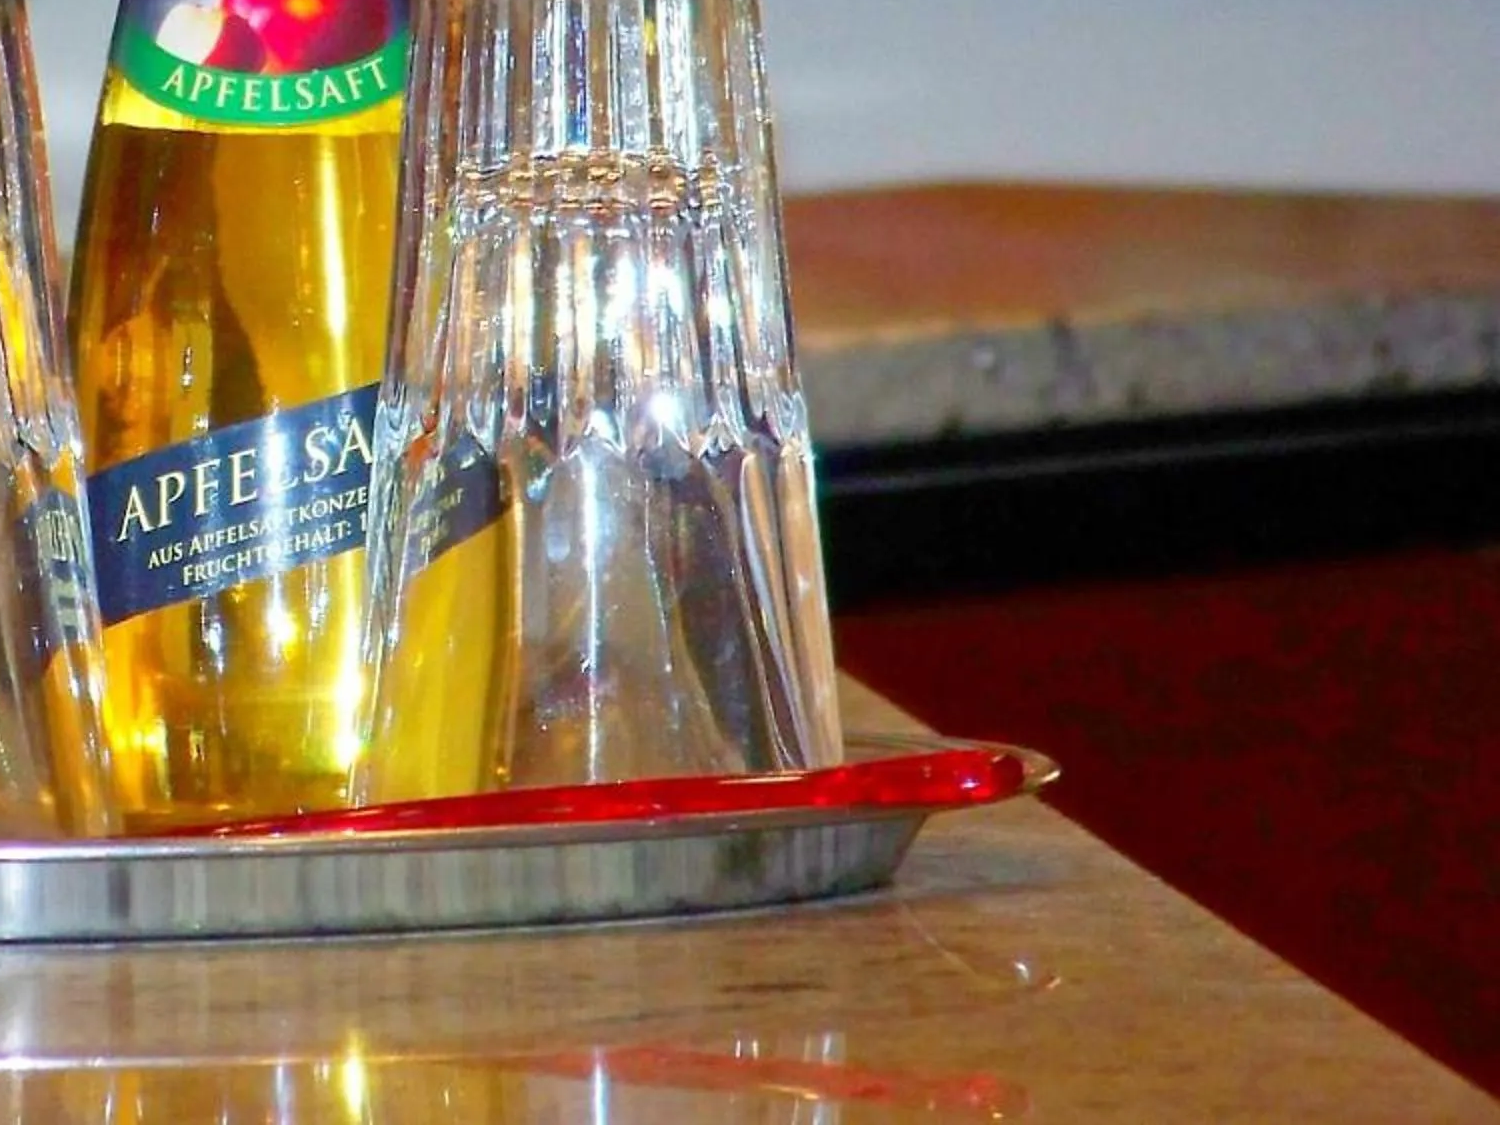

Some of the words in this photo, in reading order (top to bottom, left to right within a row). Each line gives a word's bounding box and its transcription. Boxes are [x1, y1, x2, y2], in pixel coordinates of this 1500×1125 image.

[161, 56, 389, 113] APFELSAFT
[116, 416, 374, 543] APFELSA
[148, 543, 183, 569] AUS
